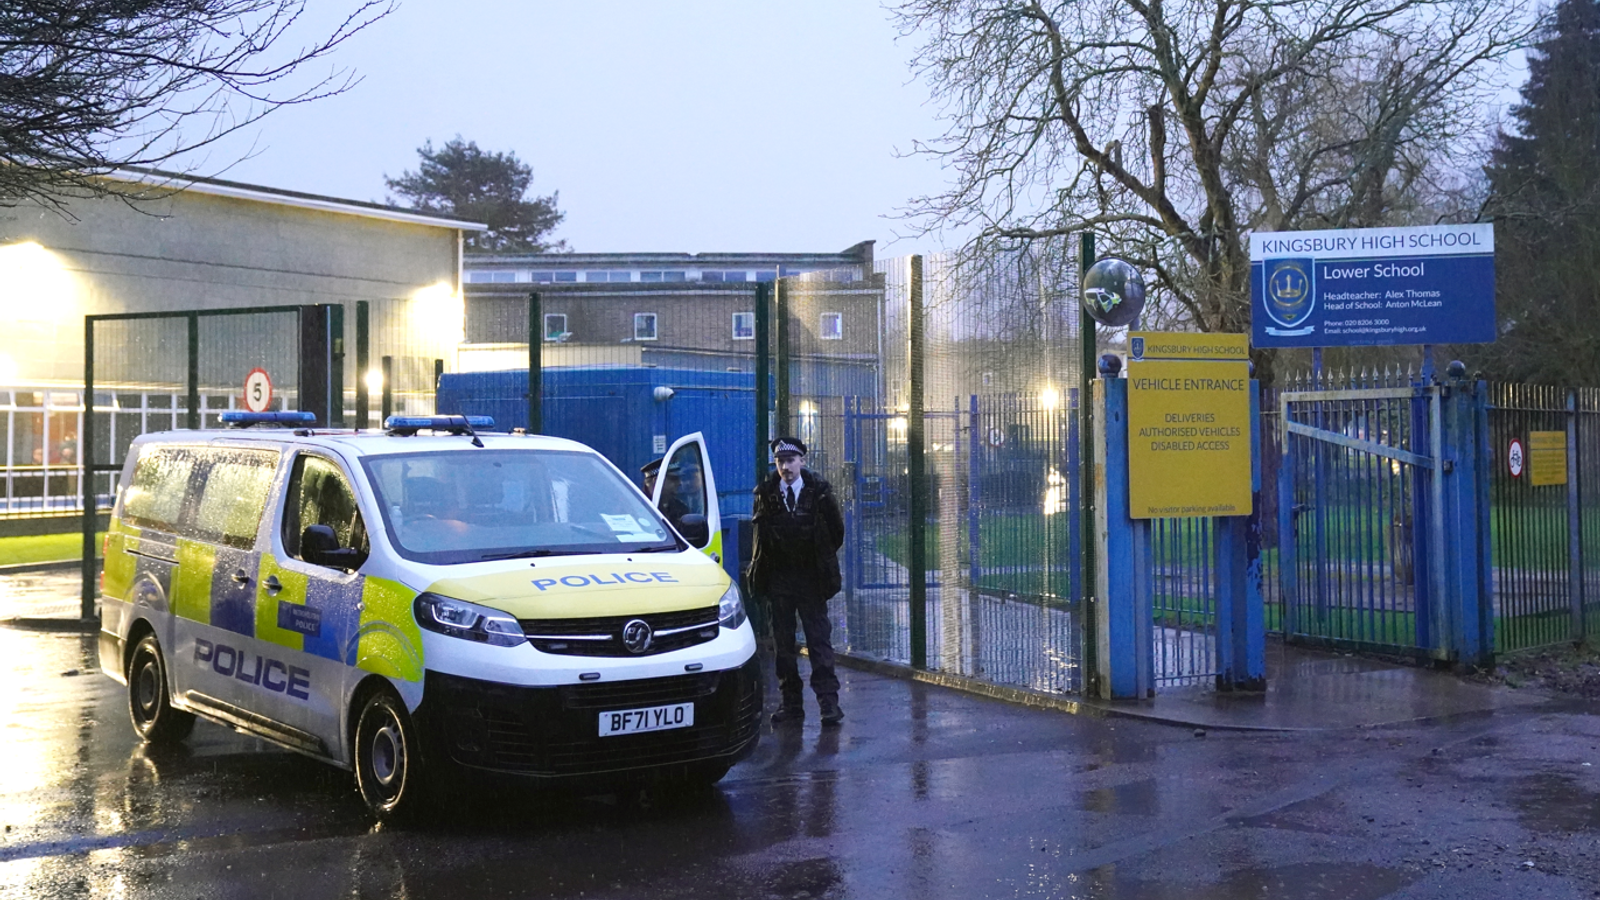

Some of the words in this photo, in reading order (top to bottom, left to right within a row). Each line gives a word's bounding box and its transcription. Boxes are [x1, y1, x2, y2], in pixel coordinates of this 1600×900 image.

[1262, 237, 1357, 254] KINGSBURY
[1361, 235, 1404, 250] HIGH
[1409, 232, 1481, 248] SCHOOL
[1324, 266, 1370, 280] Lower
[1373, 262, 1425, 278] School
[1324, 291, 1382, 300] Headteacher:
[1385, 290, 1404, 298] Alex
[1406, 290, 1440, 298] Thomas
[1324, 302, 1344, 310] Head
[1354, 302, 1382, 310] School:
[1147, 346, 1192, 354] KINGSBURY
[1193, 346, 1214, 354] HIGH
[1214, 346, 1246, 354] SCHOOL
[1132, 378, 1182, 391] VEHICLE
[1184, 378, 1245, 392] ENTRANCE
[253, 383, 262, 402] 5
[1165, 413, 1215, 423] DELIVERIES
[1139, 427, 1198, 437] AUTHORISED
[1198, 426, 1240, 436] VEHICLES
[1150, 441, 1194, 451] DISABLED
[1196, 440, 1230, 450] ACCESS
[1182, 505, 1206, 514] parking
[530, 571, 679, 591] POLICE
[296, 618, 316, 632] POLICE
[192, 638, 310, 700] POLICE
[611, 710, 648, 732] BF71
[654, 706, 684, 726] YLO
